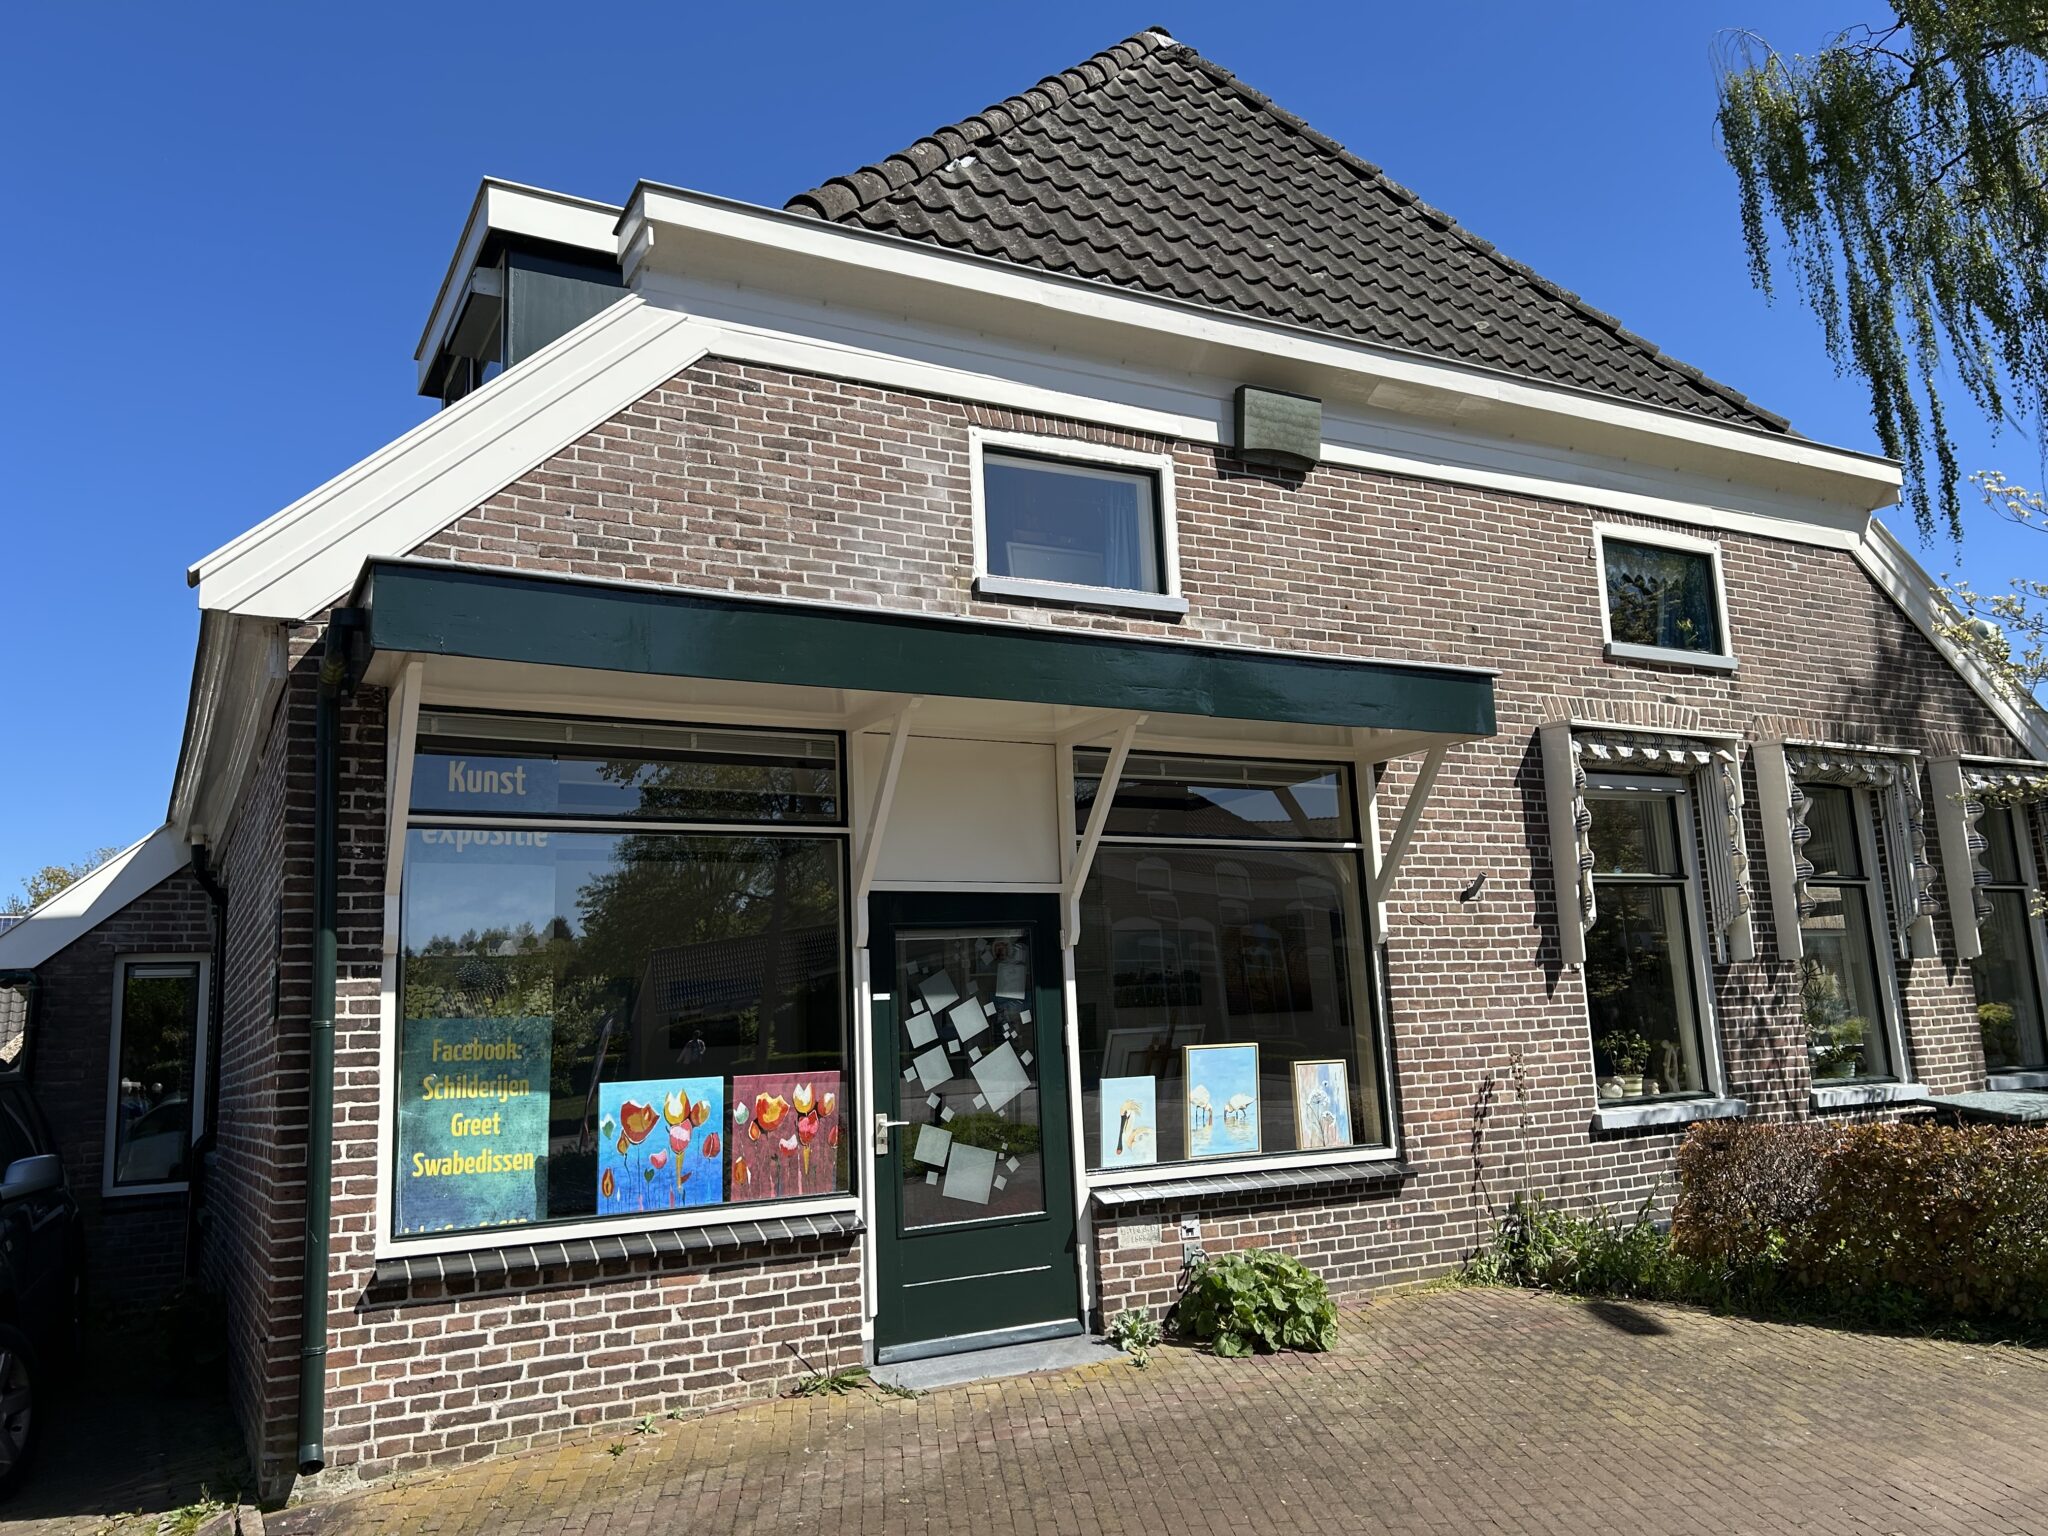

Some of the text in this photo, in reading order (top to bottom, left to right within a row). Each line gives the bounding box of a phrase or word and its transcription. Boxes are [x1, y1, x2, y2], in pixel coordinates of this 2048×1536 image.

[449, 760, 526, 795] Kunst
[432, 1034, 523, 1062] Facebook:
[422, 1073, 530, 1103] Schilderijen
[451, 1111, 501, 1137] Greet
[412, 1148, 534, 1178] Swabedissen
